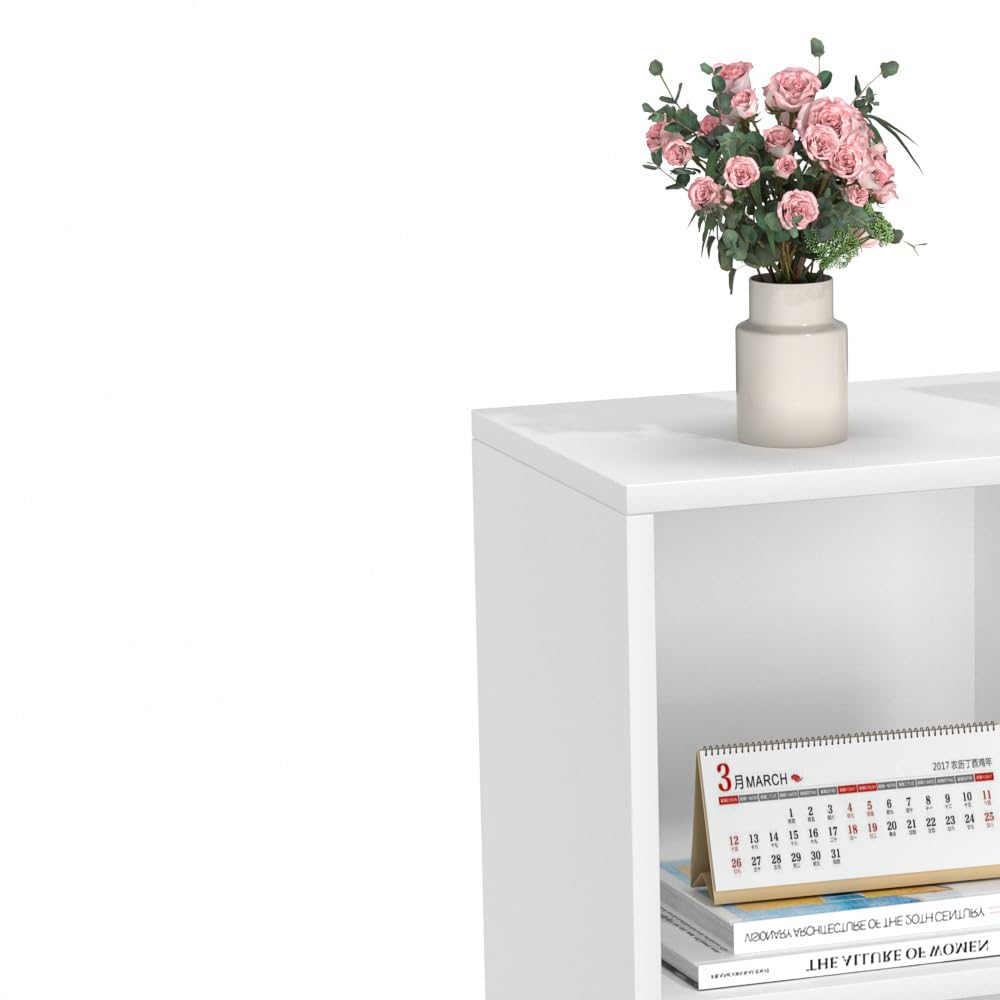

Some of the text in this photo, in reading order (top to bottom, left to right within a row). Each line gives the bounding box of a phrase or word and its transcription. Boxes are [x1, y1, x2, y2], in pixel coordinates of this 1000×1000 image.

[932, 761, 950, 771] 2017
[746, 772, 788, 789] MARCH
[789, 808, 794, 818] 1
[807, 806, 814, 816] 2
[827, 804, 833, 815] 3
[847, 802, 853, 813] 4
[866, 800, 873, 811] 5
[886, 798, 892, 809] 6
[906, 797, 911, 807] 7
[925, 795, 931, 806] 8
[945, 793, 951, 804] 9
[962, 791, 973, 802] 10
[982, 789, 992, 801] 11
[729, 811, 995, 846] 12 13 14 15 16 17 18 19 20 21 22 23 24 25
[731, 848, 841, 869] 26 27 28 29 30 31
